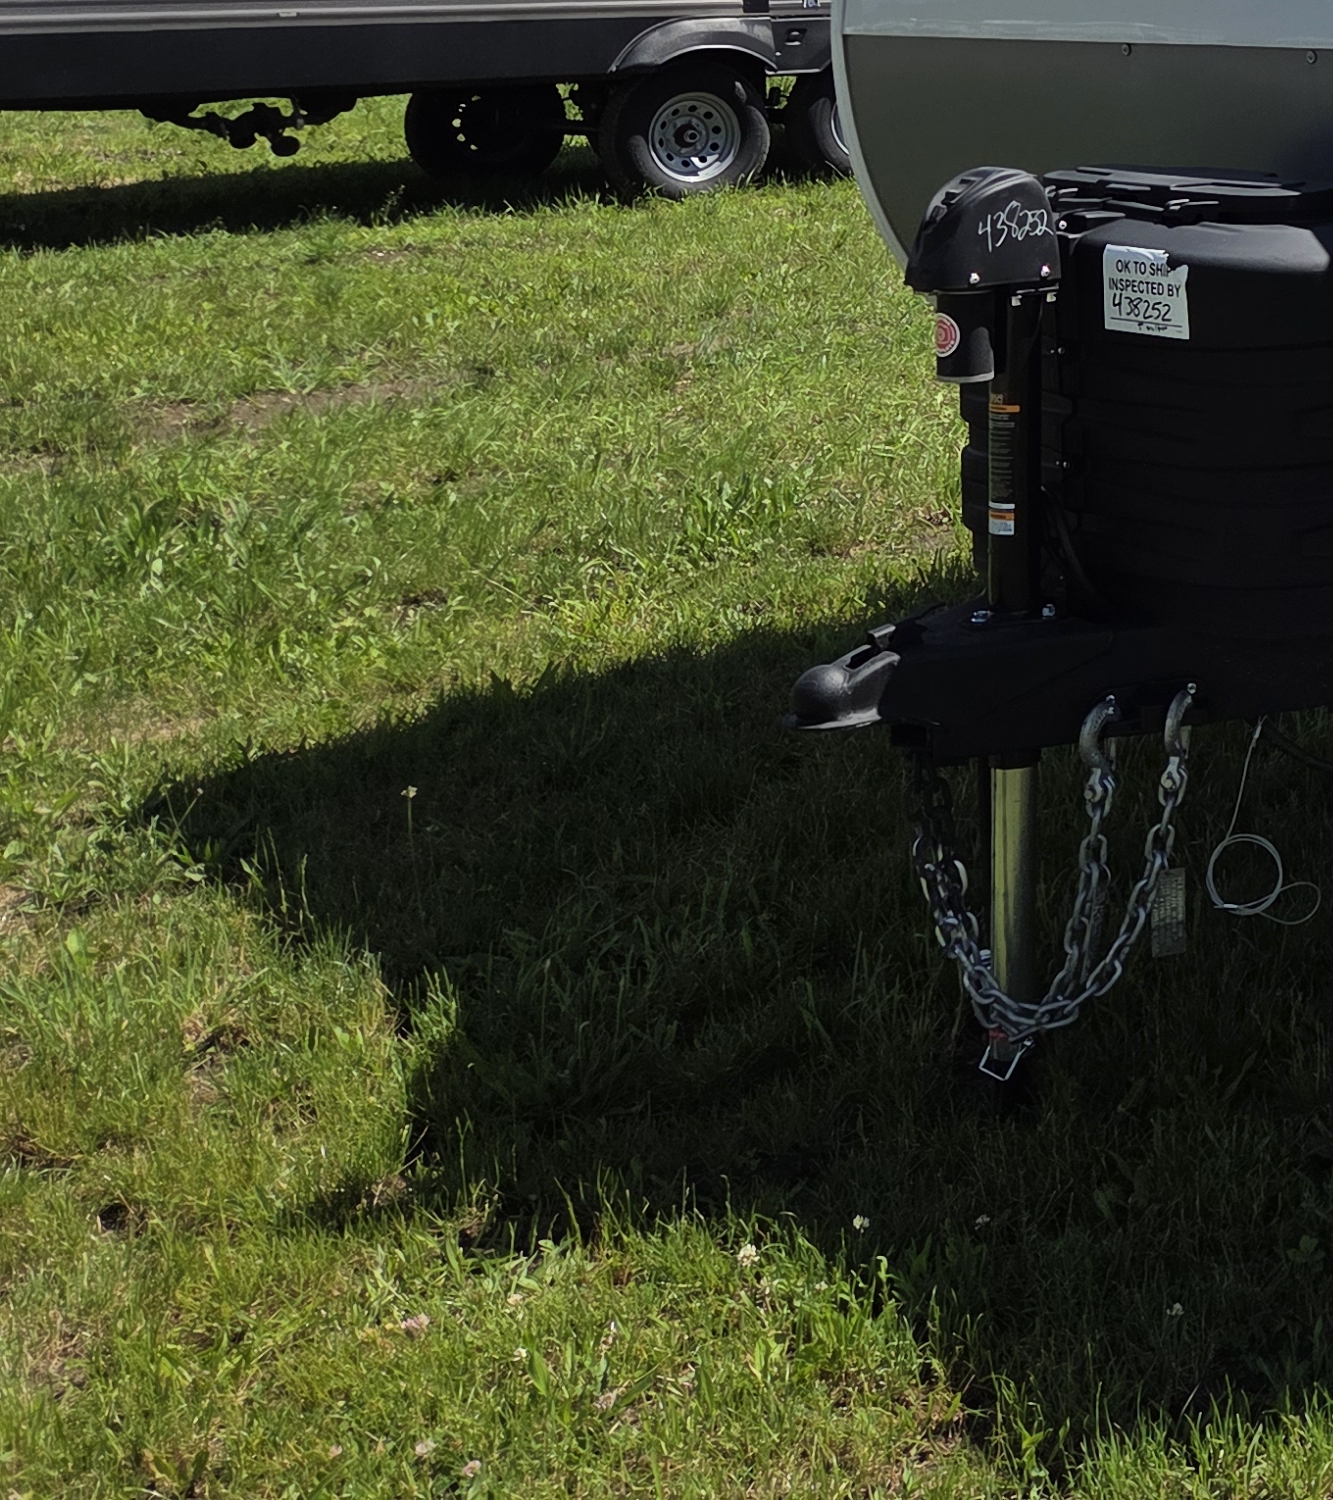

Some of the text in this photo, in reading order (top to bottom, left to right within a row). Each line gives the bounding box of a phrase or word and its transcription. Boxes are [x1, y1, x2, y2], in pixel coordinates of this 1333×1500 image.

[978, 200, 1054, 253] 438252
[1115, 259, 1131, 275] OK
[1133, 261, 1147, 276] TO
[1109, 277, 1182, 298] INSPECTED BY
[1112, 293, 1172, 322] 438252
